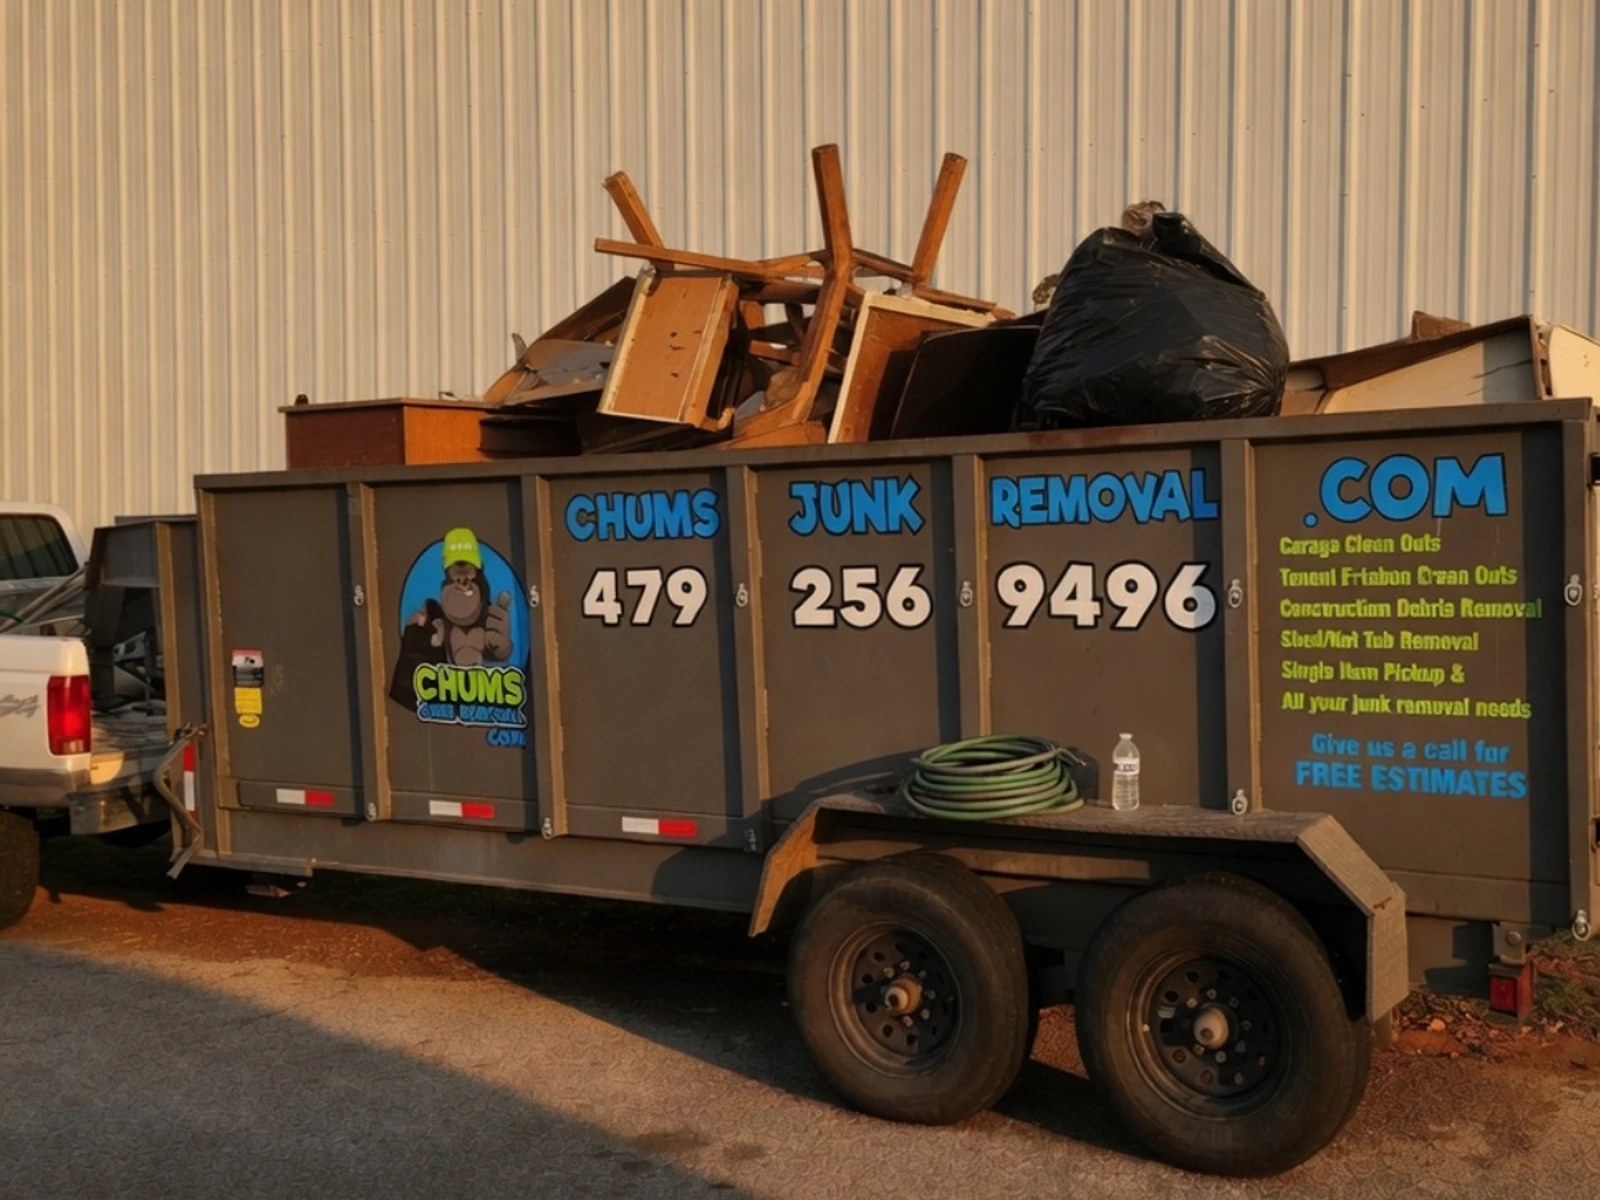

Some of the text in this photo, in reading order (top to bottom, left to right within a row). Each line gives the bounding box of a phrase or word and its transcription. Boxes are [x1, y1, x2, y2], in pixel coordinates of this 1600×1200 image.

[564, 453, 1508, 541] CHUMS JUNK REMOVAL .COM
[1400, 533, 1441, 552] Outs
[1475, 565, 1518, 585] Outs
[582, 560, 1218, 632] 479 256 9496
[1460, 597, 1542, 618] Removal
[1362, 630, 1394, 649] Tub
[1400, 630, 1480, 651] Removal
[414, 662, 526, 707] CHUMS
[1450, 663, 1466, 683] &
[1281, 691, 1305, 710] All
[1308, 695, 1349, 715] your
[1351, 693, 1392, 715] junk
[1475, 698, 1532, 719] needs
[1311, 731, 1510, 763] Give us a call for
[1295, 760, 1528, 799] FREE ESTIMATES
